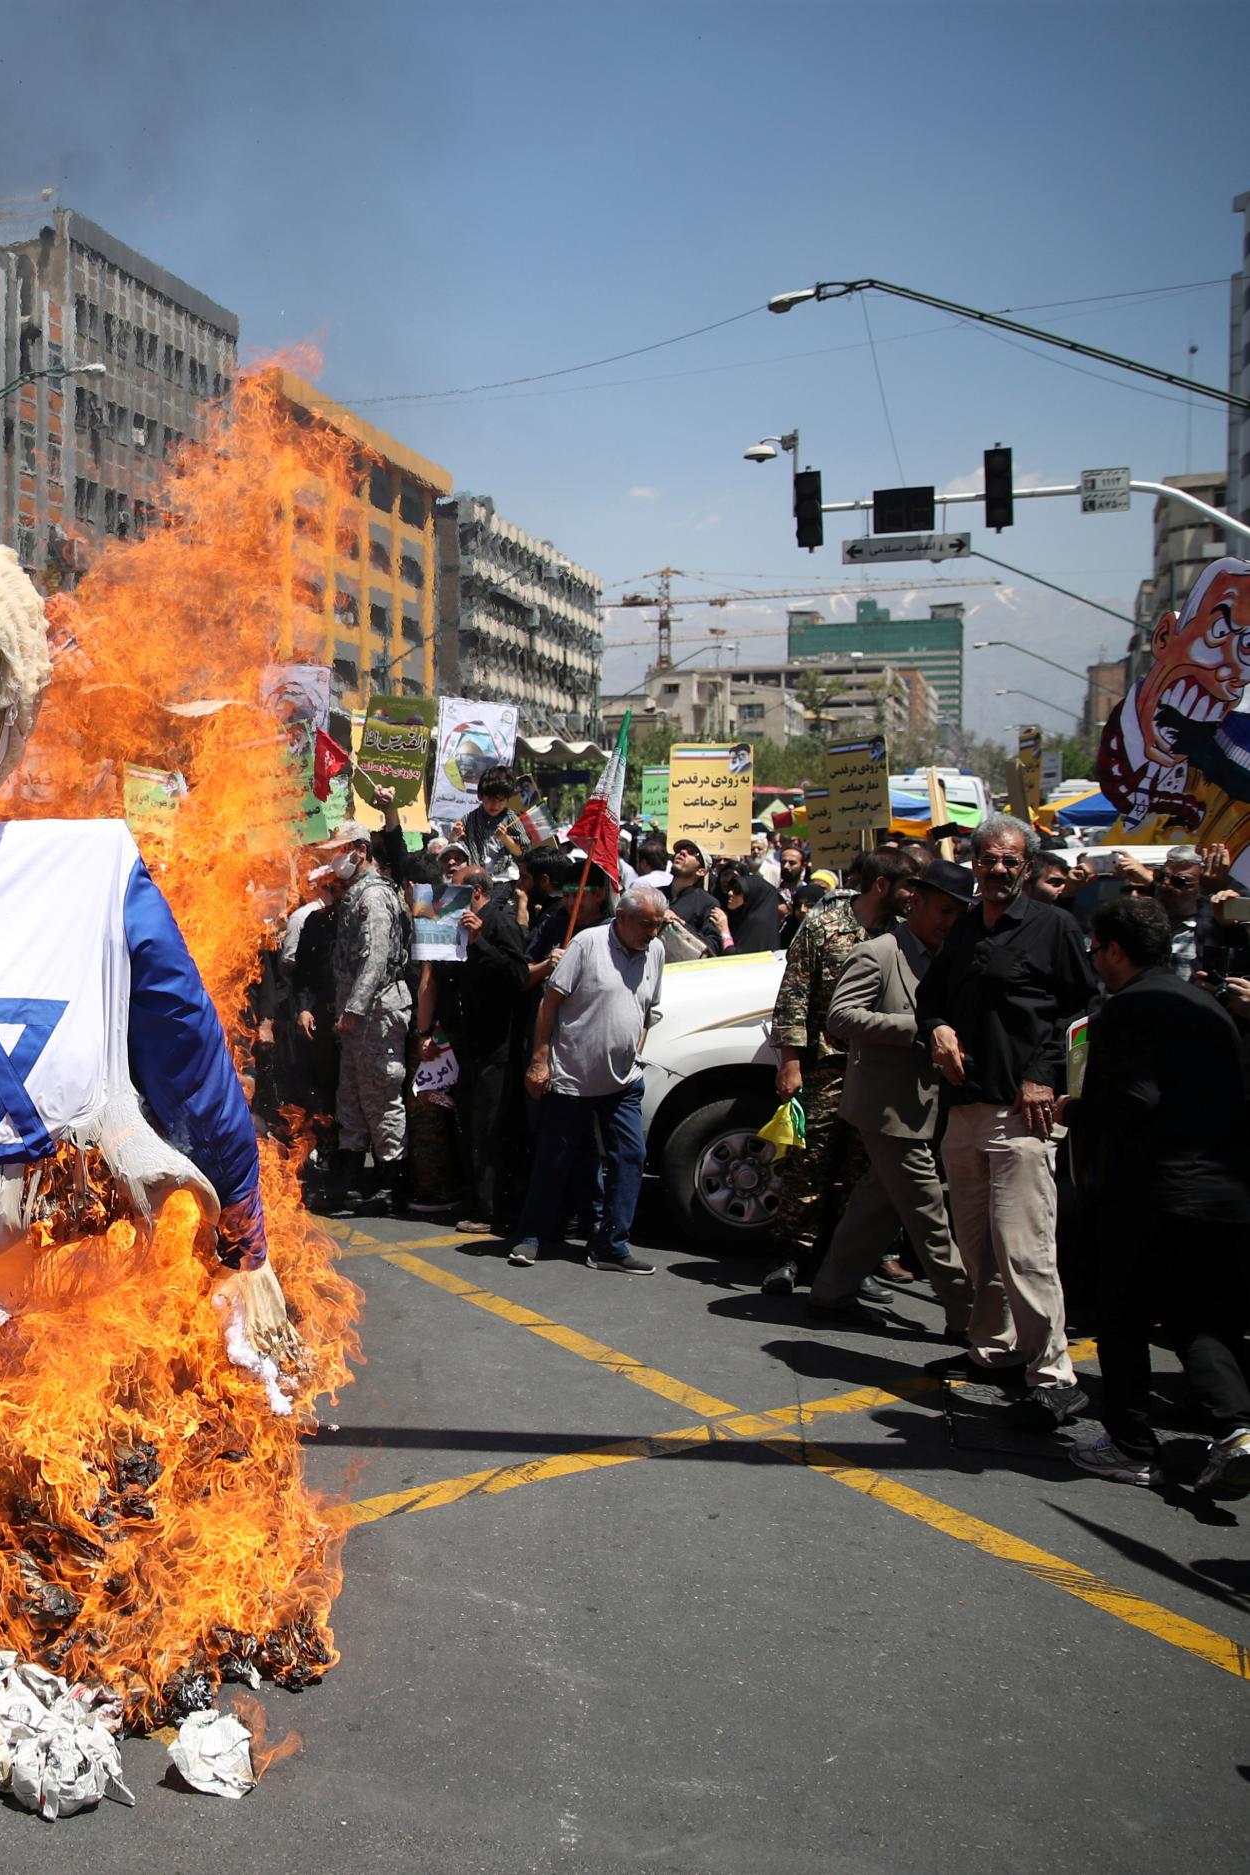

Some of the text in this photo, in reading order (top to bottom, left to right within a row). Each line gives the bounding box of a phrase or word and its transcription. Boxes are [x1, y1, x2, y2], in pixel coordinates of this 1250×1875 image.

[377, 732, 427, 754] القدس
[830, 764, 848, 779] قدس
[849, 765, 857, 777] در
[858, 764, 878, 775] زودی
[672, 772, 750, 788] به زودی در قدس
[839, 782, 864, 794] جماعت
[683, 795, 738, 810] نماز جماعت
[416, 1058, 454, 1087] امریکا
